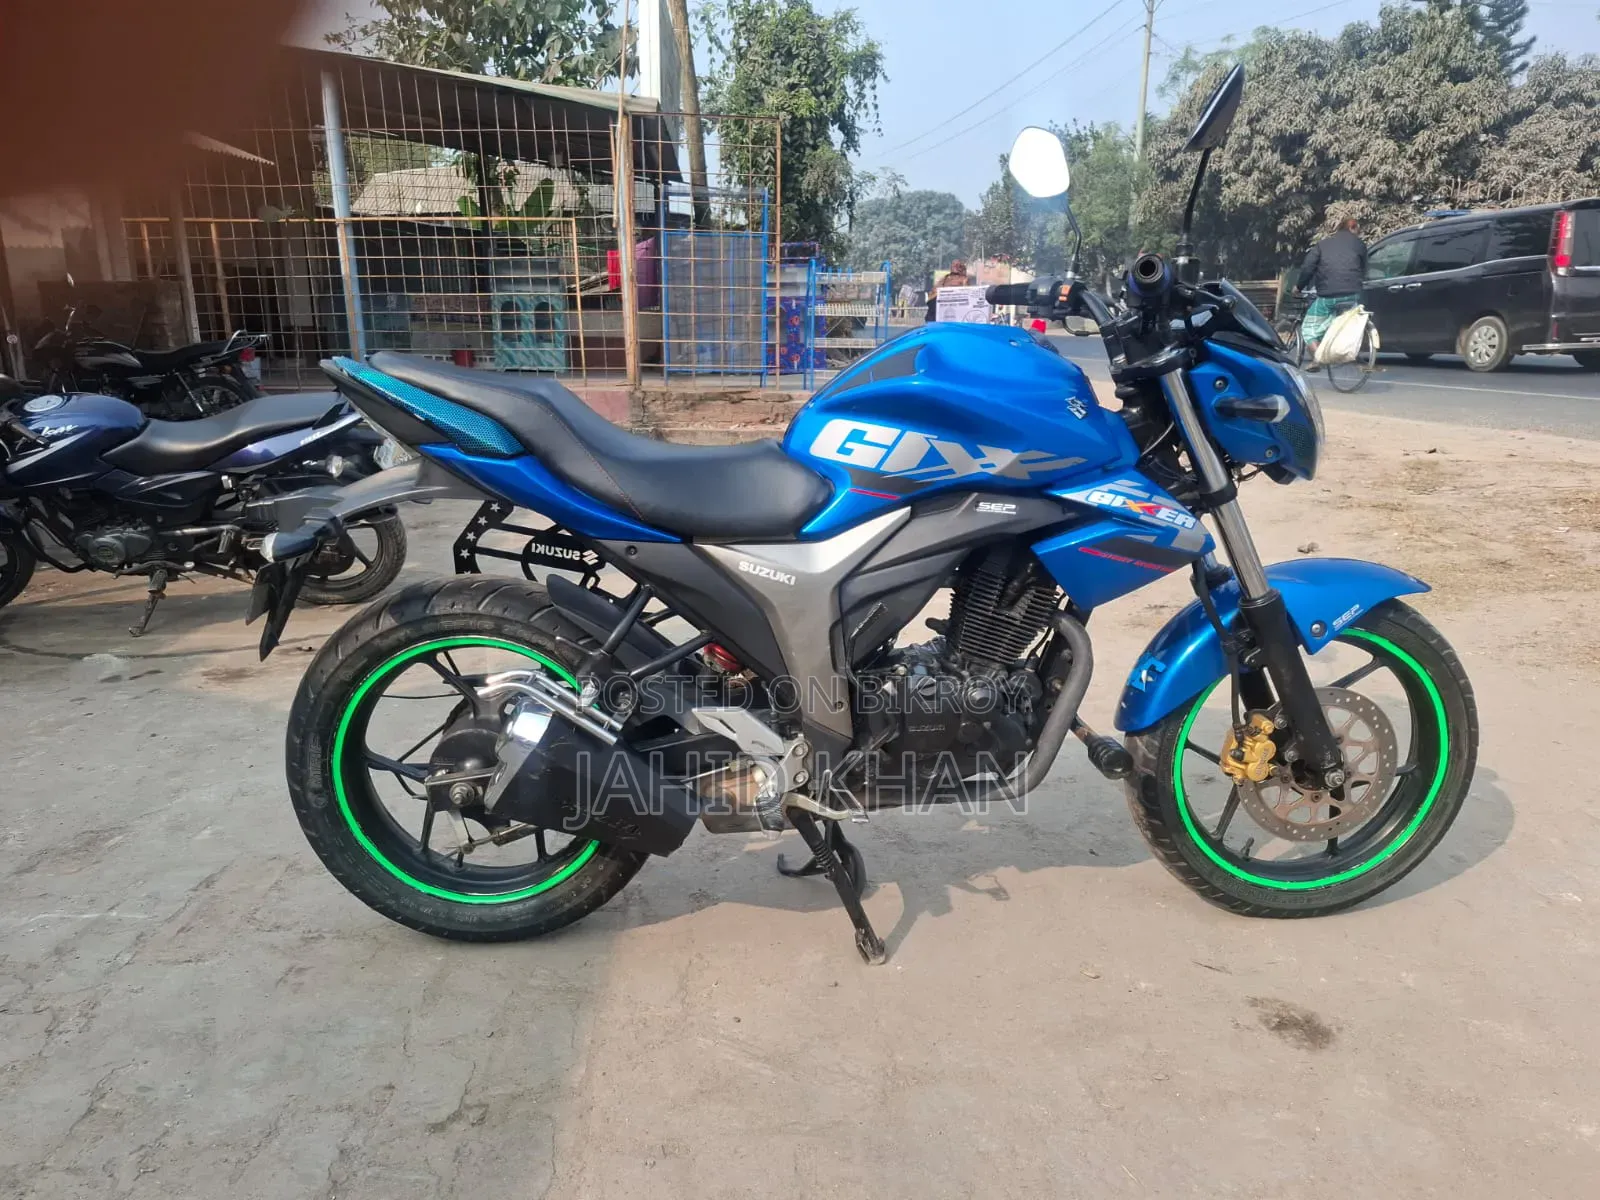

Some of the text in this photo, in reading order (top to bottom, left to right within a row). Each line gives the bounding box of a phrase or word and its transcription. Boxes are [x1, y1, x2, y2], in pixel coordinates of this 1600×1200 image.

[977, 501, 1017, 513] SEP
[1086, 489, 1197, 529] GIXXER
[738, 560, 796, 585] SUZUKI
